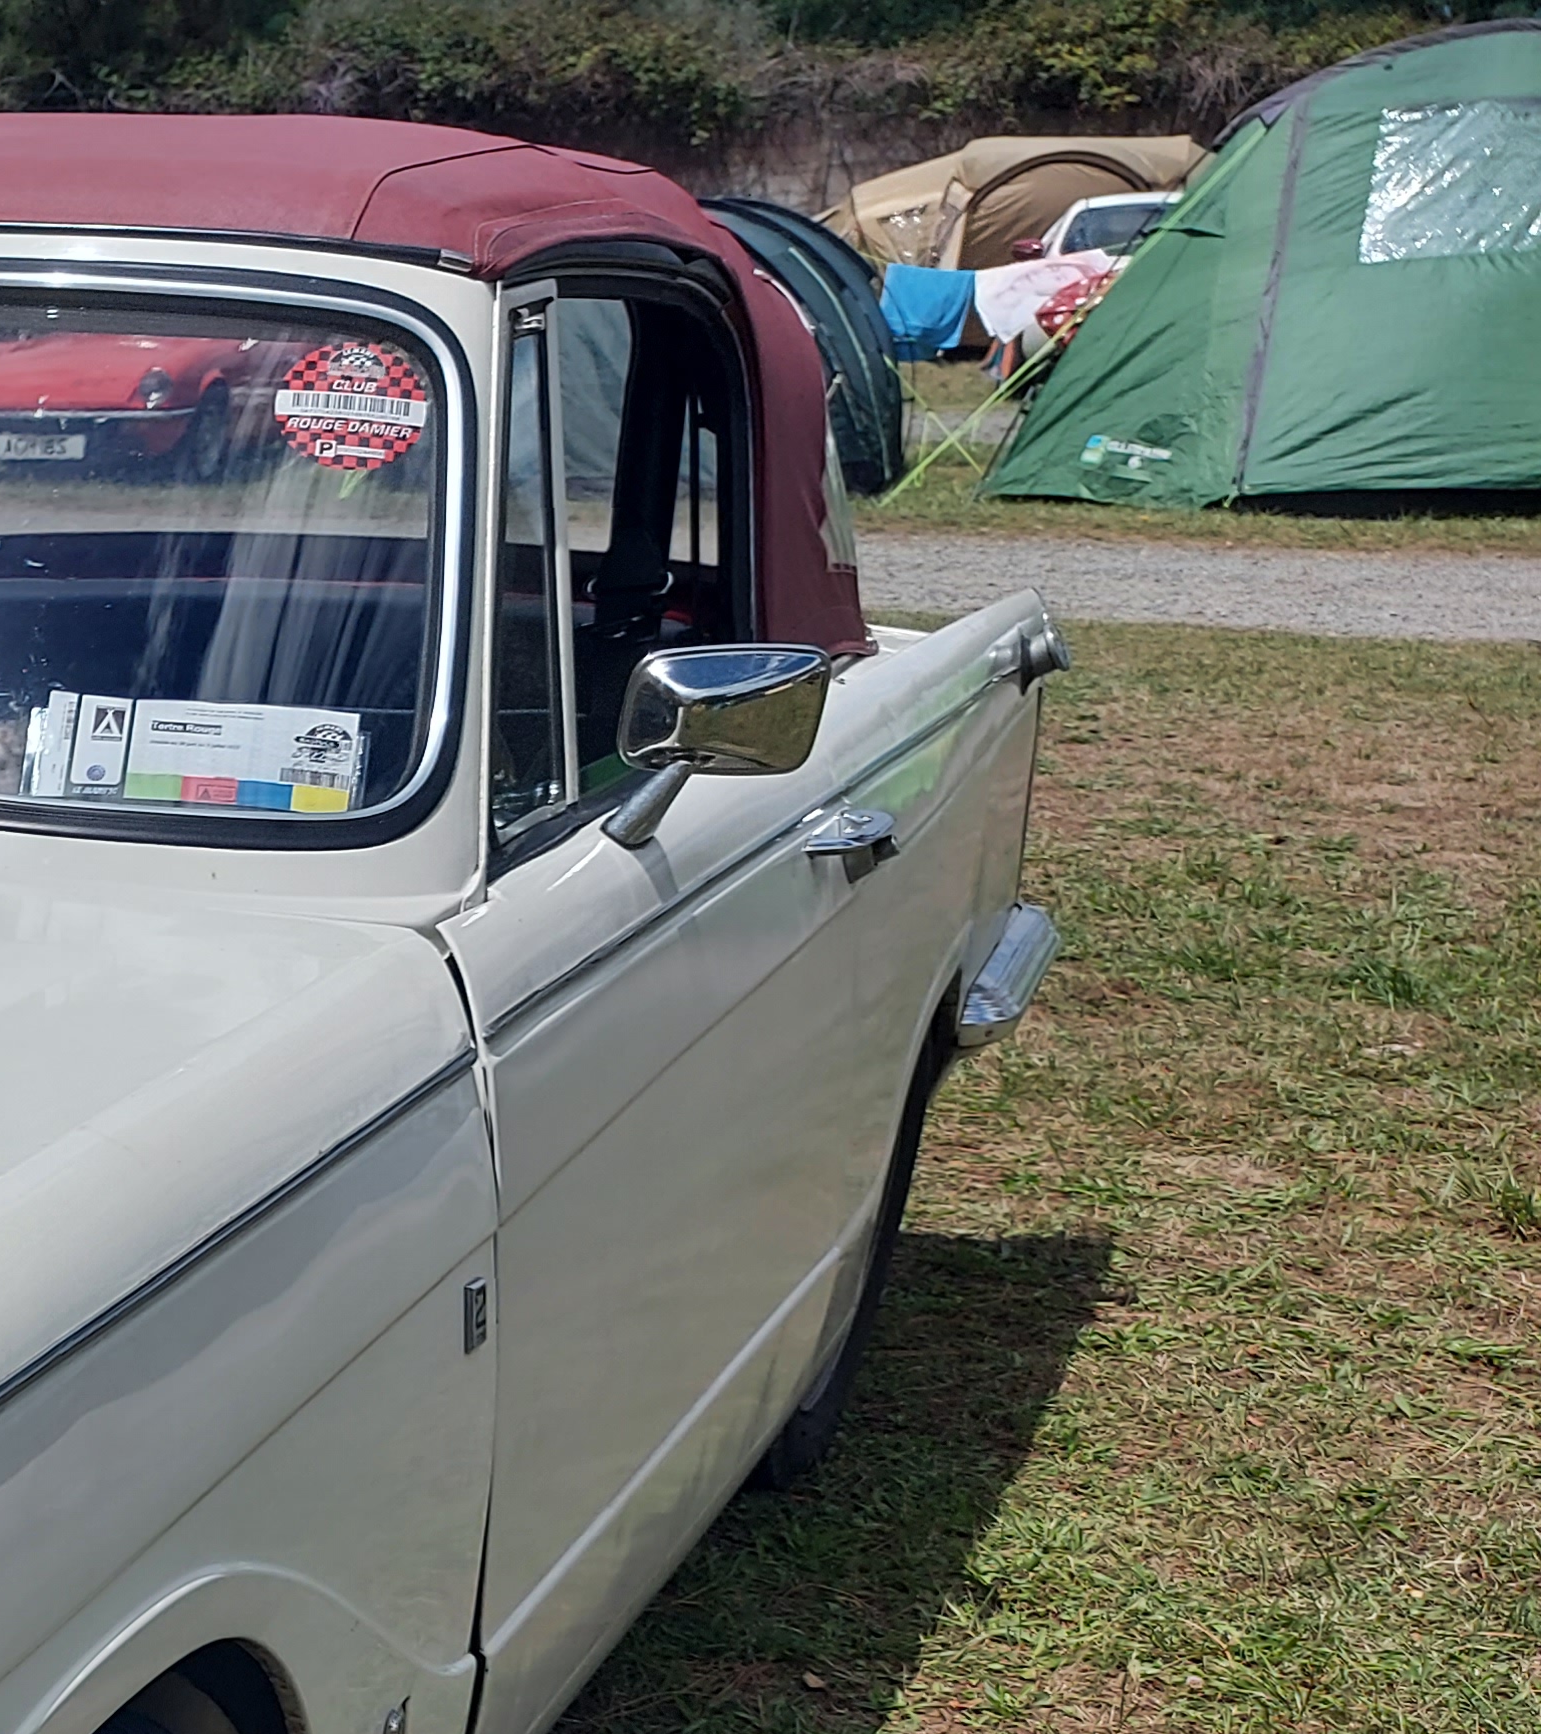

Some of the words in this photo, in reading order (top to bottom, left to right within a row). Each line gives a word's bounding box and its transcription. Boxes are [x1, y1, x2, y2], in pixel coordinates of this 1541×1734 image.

[332, 379, 378, 393] CLUB
[286, 416, 348, 432] ROUGE
[347, 420, 414, 439] DAMIER
